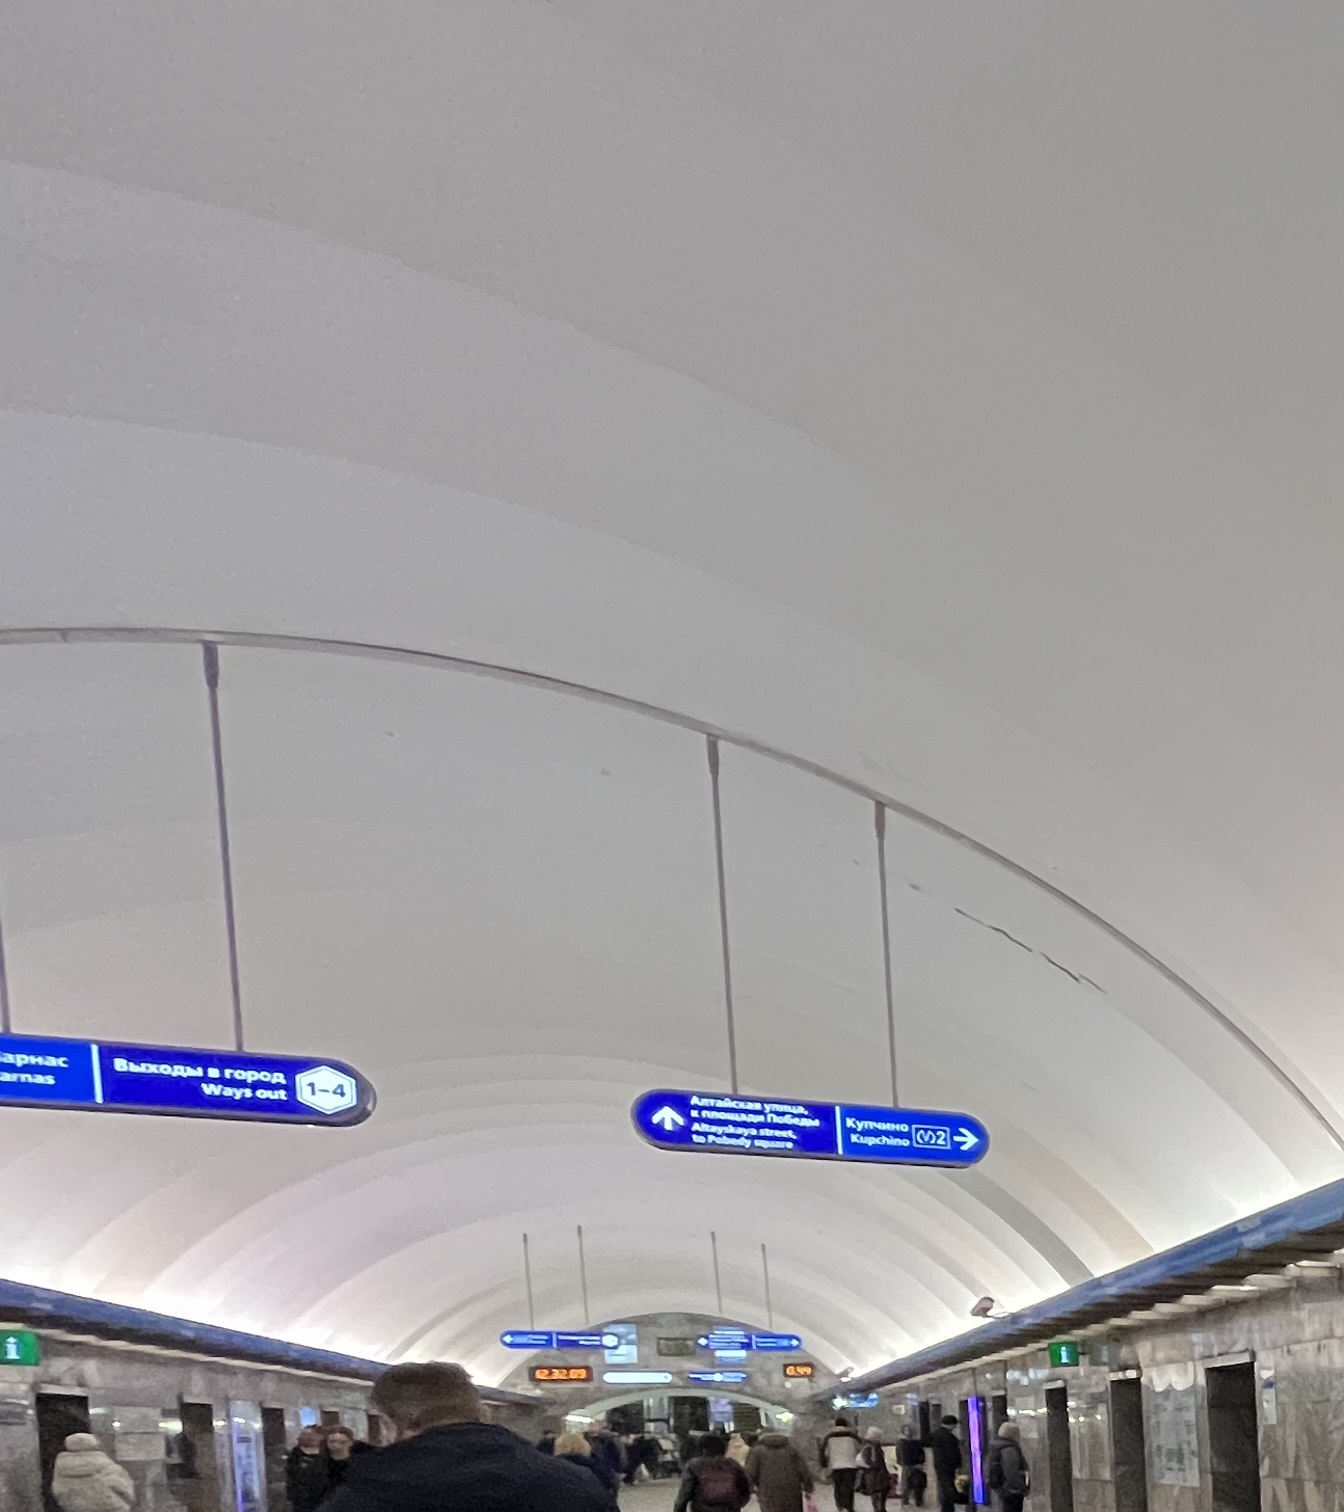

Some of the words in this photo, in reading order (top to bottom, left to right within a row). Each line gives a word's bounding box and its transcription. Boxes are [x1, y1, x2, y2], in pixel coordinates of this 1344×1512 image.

[0, 1050, 69, 1067] арнас
[0, 1071, 56, 1085] arnas
[113, 1057, 204, 1078] Выходы
[207, 1067, 221, 1079] в
[224, 1069, 288, 1085] город
[201, 1083, 253, 1101] Ways
[257, 1087, 288, 1100] out
[845, 1117, 909, 1132] Купчино
[850, 1133, 911, 1147] Kupchino
